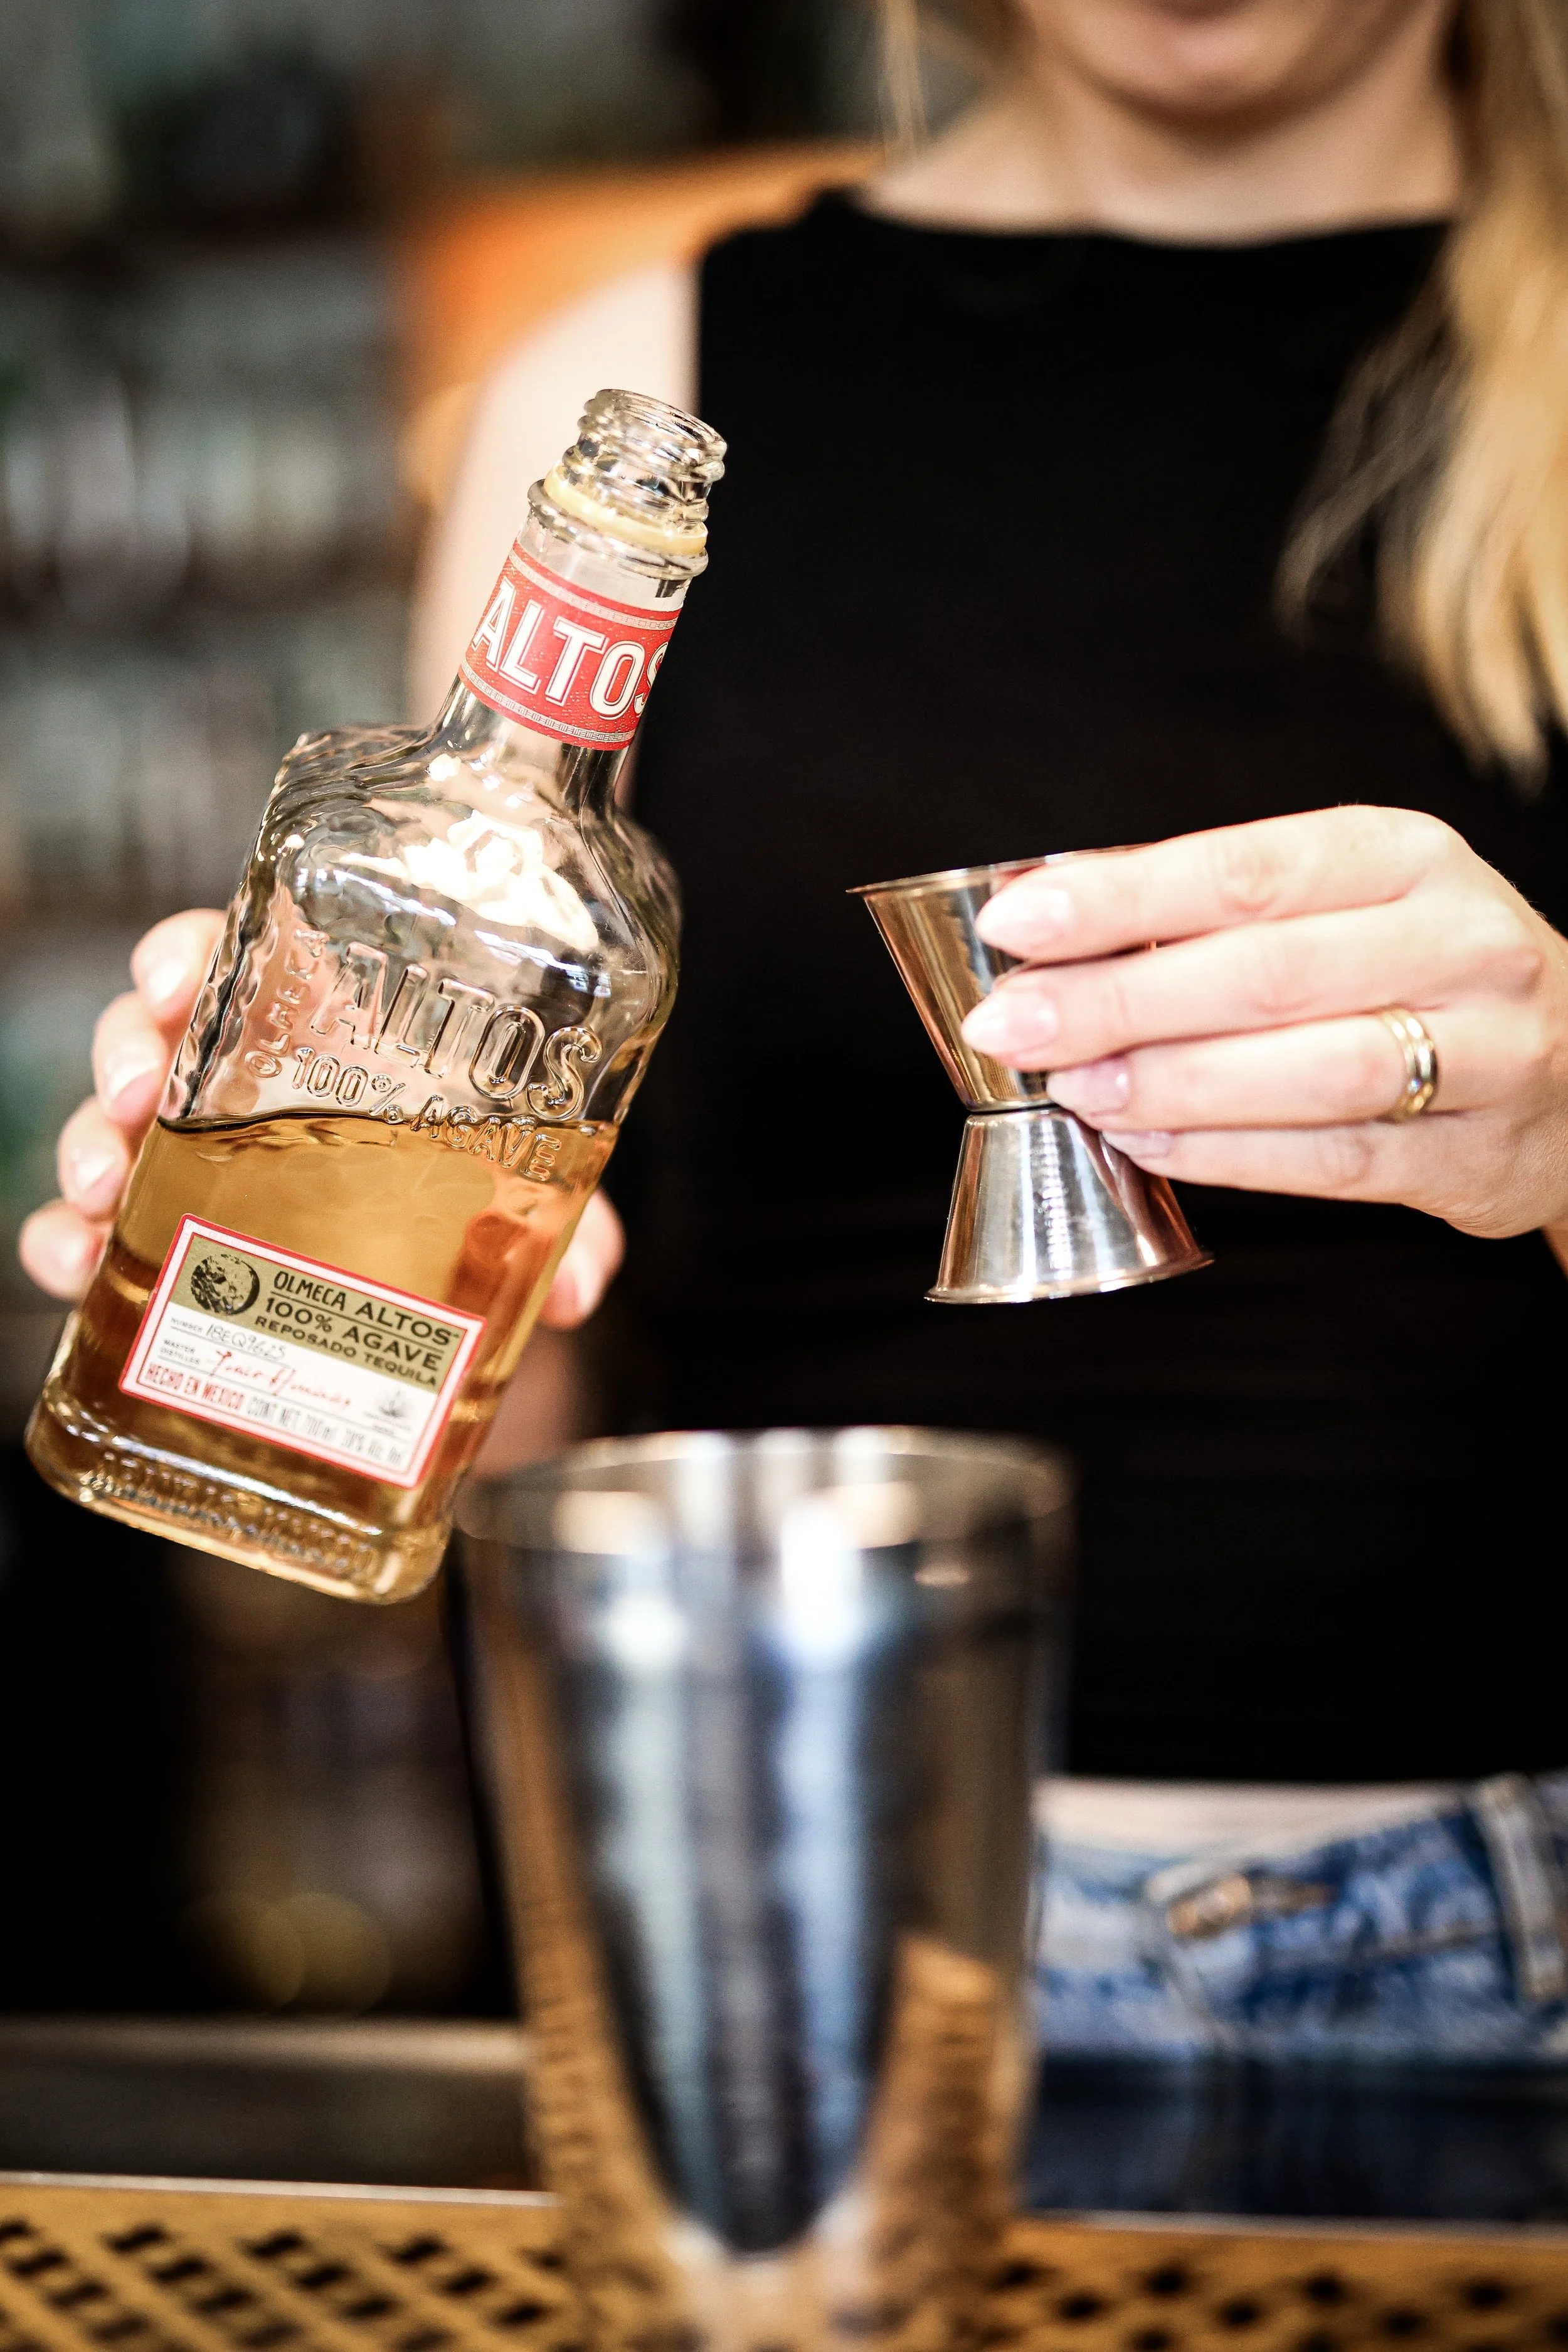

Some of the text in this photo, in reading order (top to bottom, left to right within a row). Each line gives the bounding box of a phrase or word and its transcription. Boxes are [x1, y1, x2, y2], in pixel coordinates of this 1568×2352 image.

[311, 941, 602, 1120] ALTOS
[292, 1046, 563, 1182] 100% AGAVE
[171, 1317, 203, 1333] NUMBER
[265, 1297, 443, 1372] 100% AGAVE
[273, 1270, 453, 1347] OLMECA ALTOS
[253, 1315, 358, 1358] REPOSADO
[364, 1352, 437, 1387] TEQUILA
